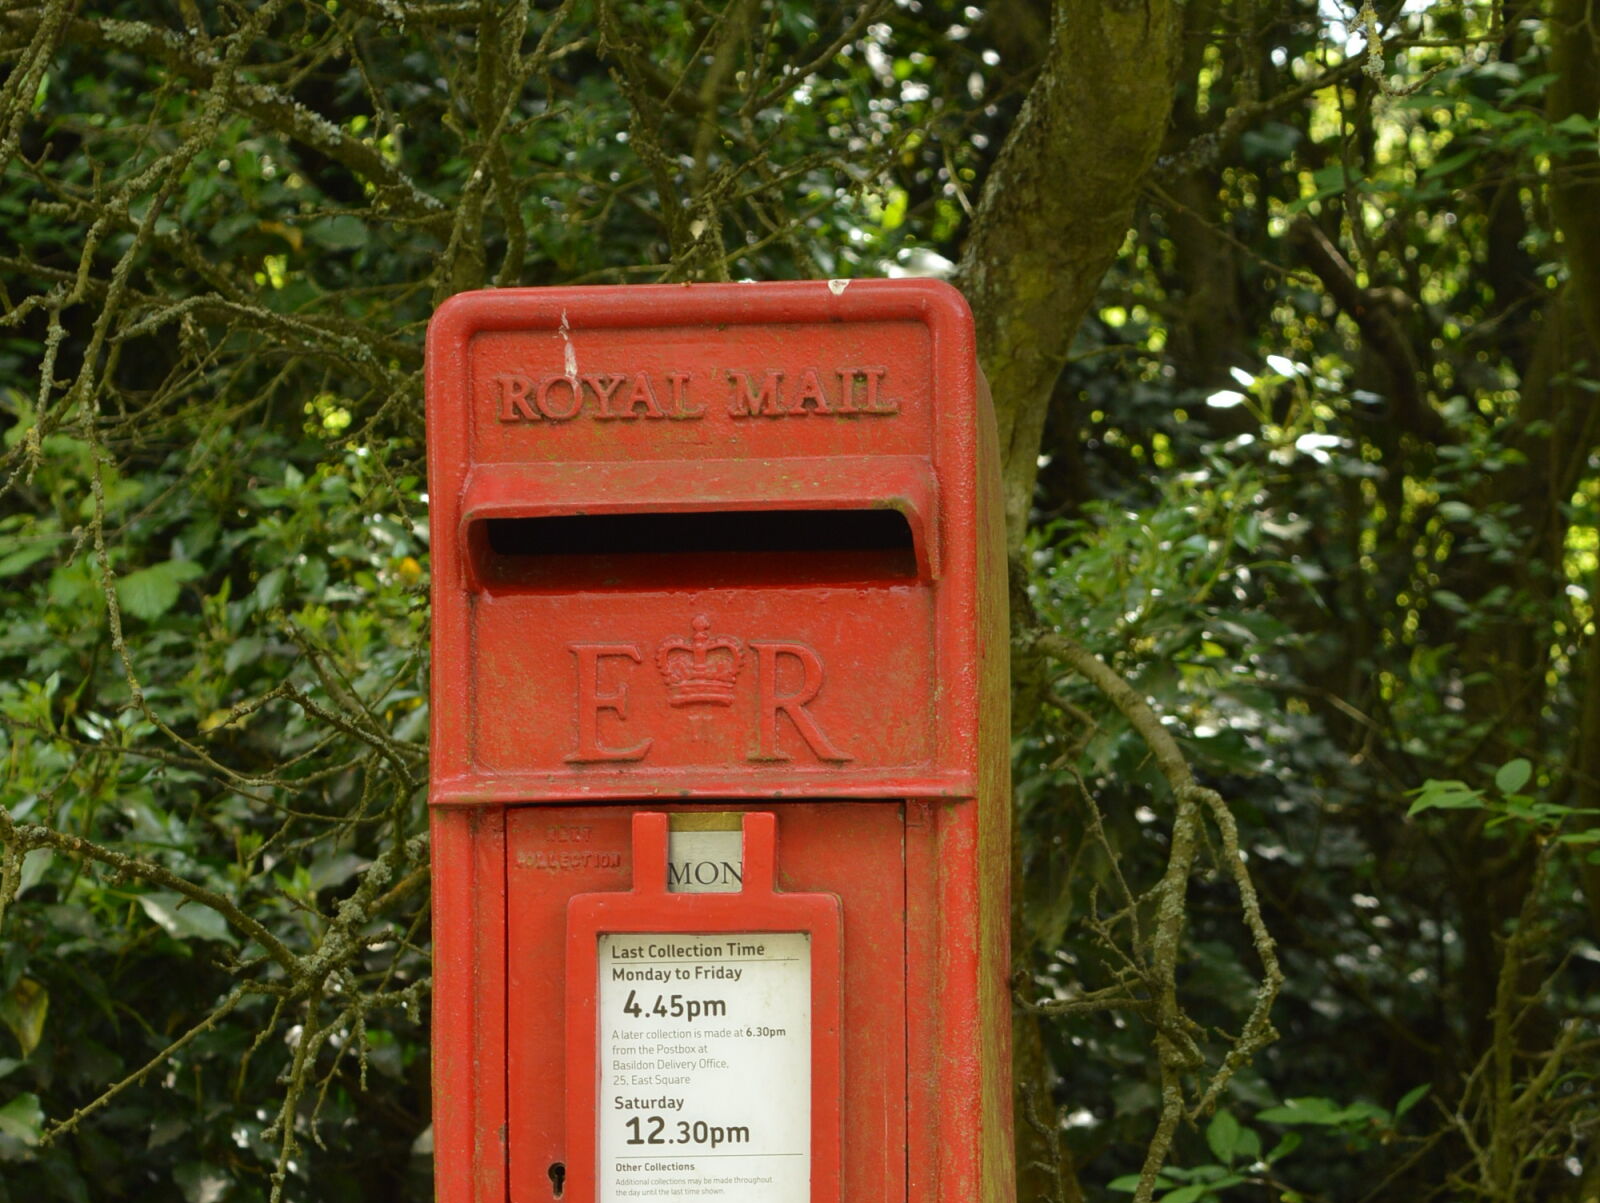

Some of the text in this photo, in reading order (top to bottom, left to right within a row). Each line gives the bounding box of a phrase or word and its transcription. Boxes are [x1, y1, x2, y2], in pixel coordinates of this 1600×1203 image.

[497, 365, 899, 423] ROYAL MAIL
[562, 638, 855, 764] E R
[667, 861, 743, 886] MON
[611, 942, 766, 960] Last Collection Time
[611, 965, 743, 984] Monday to Friday
[622, 989, 727, 1023] 4.45pm
[611, 1026, 787, 1041] A later collection is made at 6.30pm
[611, 1044, 708, 1056] from the Postbox at
[612, 1059, 656, 1071] Basildon
[657, 1058, 698, 1071] Delivery
[631, 1075, 653, 1086] East
[654, 1074, 692, 1087] Square
[614, 1095, 685, 1112] Saturday
[624, 1115, 751, 1149] 12.30pm
[615, 1162, 696, 1173] Other Collections
